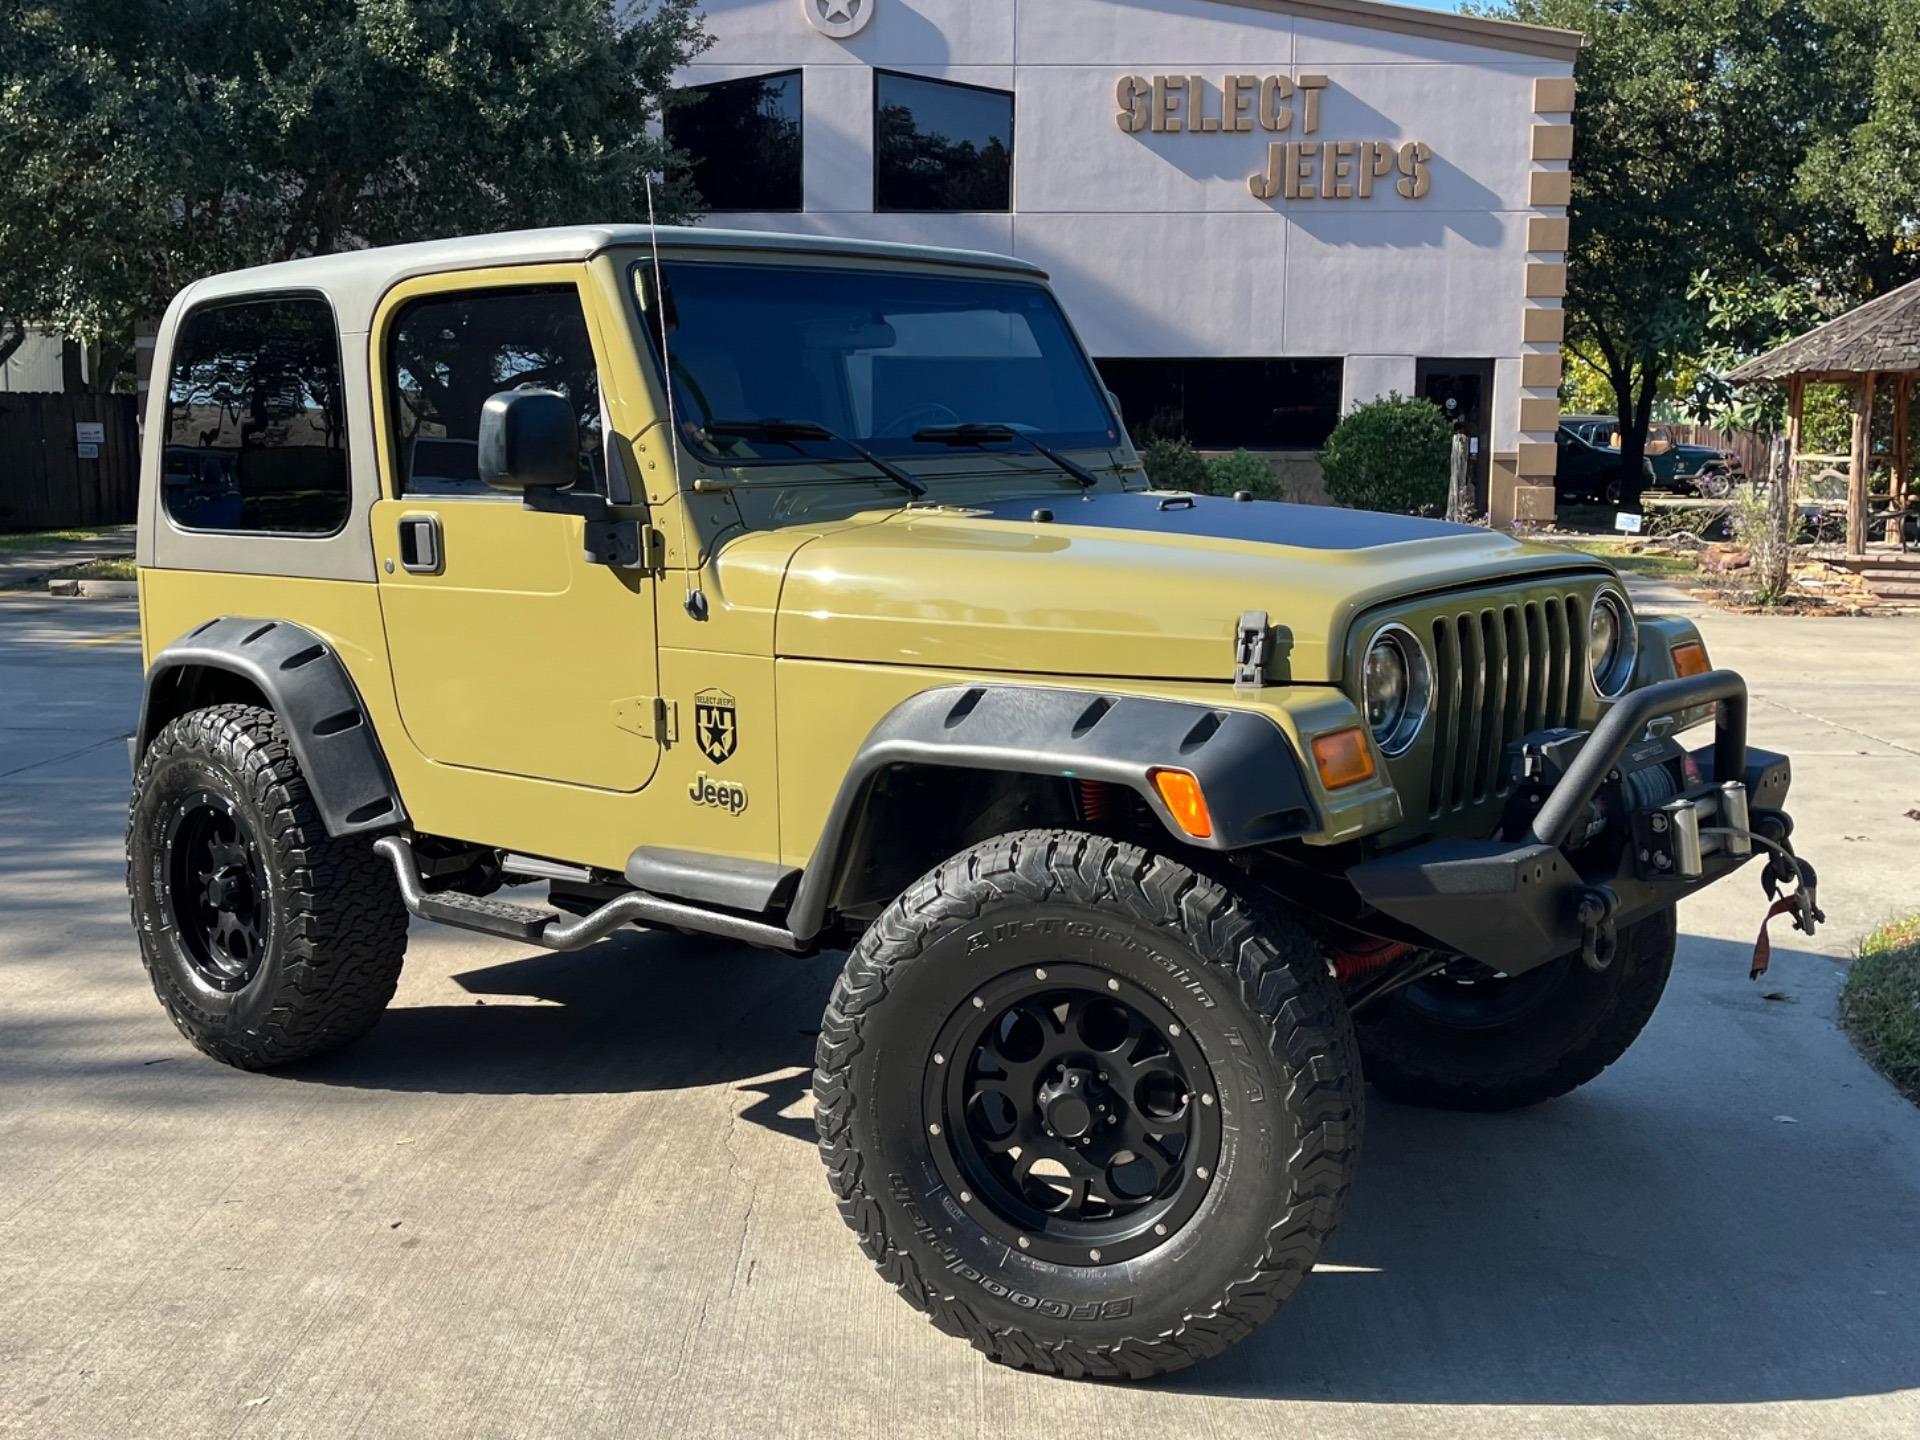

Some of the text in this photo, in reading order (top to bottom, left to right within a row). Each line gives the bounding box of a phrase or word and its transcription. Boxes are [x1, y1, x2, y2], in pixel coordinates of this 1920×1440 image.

[1115, 74, 1329, 134] SELECT
[1248, 141, 1431, 199] JEEPS
[688, 772, 746, 814] Jeep
